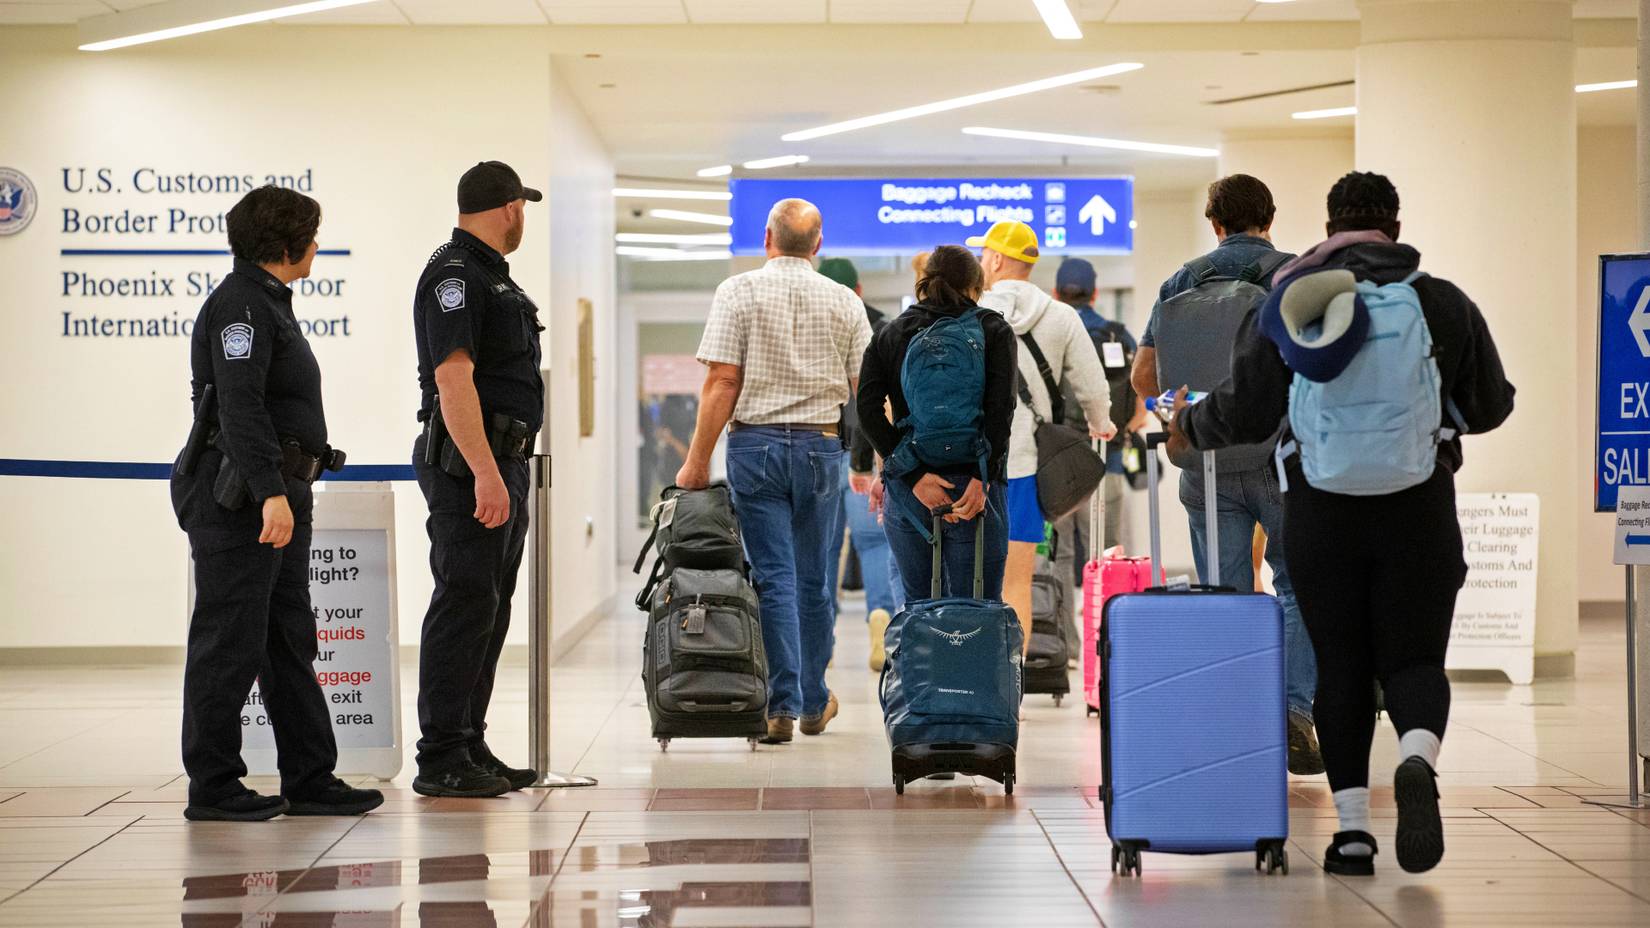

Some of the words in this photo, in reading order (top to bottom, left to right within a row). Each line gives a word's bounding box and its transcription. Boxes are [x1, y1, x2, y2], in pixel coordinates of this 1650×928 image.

[61, 167, 122, 194] U.S.
[133, 167, 253, 194] Customs
[265, 168, 313, 192] and
[881, 183, 957, 204] Baggage
[959, 182, 1034, 201] Recheck
[61, 207, 158, 234] Border
[877, 205, 975, 227] Connecting
[976, 204, 1034, 223] Flights
[61, 270, 175, 297] Phoenix
[187, 271, 218, 297] Sk
[61, 310, 195, 337] Internatio
[1457, 507, 1495, 520] engers
[1499, 505, 1528, 517] Must
[1621, 500, 1641, 511] Baggage
[1617, 517, 1645, 528] Connecting
[1462, 524, 1479, 535] eir
[1482, 523, 1534, 538] Luggage
[339, 547, 357, 560] to
[1467, 541, 1518, 556] Clearing
[1468, 560, 1505, 571] stoms
[1508, 559, 1533, 571] And
[309, 566, 360, 585] light?
[1465, 578, 1518, 589] rotection
[324, 608, 364, 623] your
[316, 625, 365, 643] quids
[316, 671, 372, 686] ggage
[331, 689, 362, 704] exit
[335, 713, 374, 725] area
